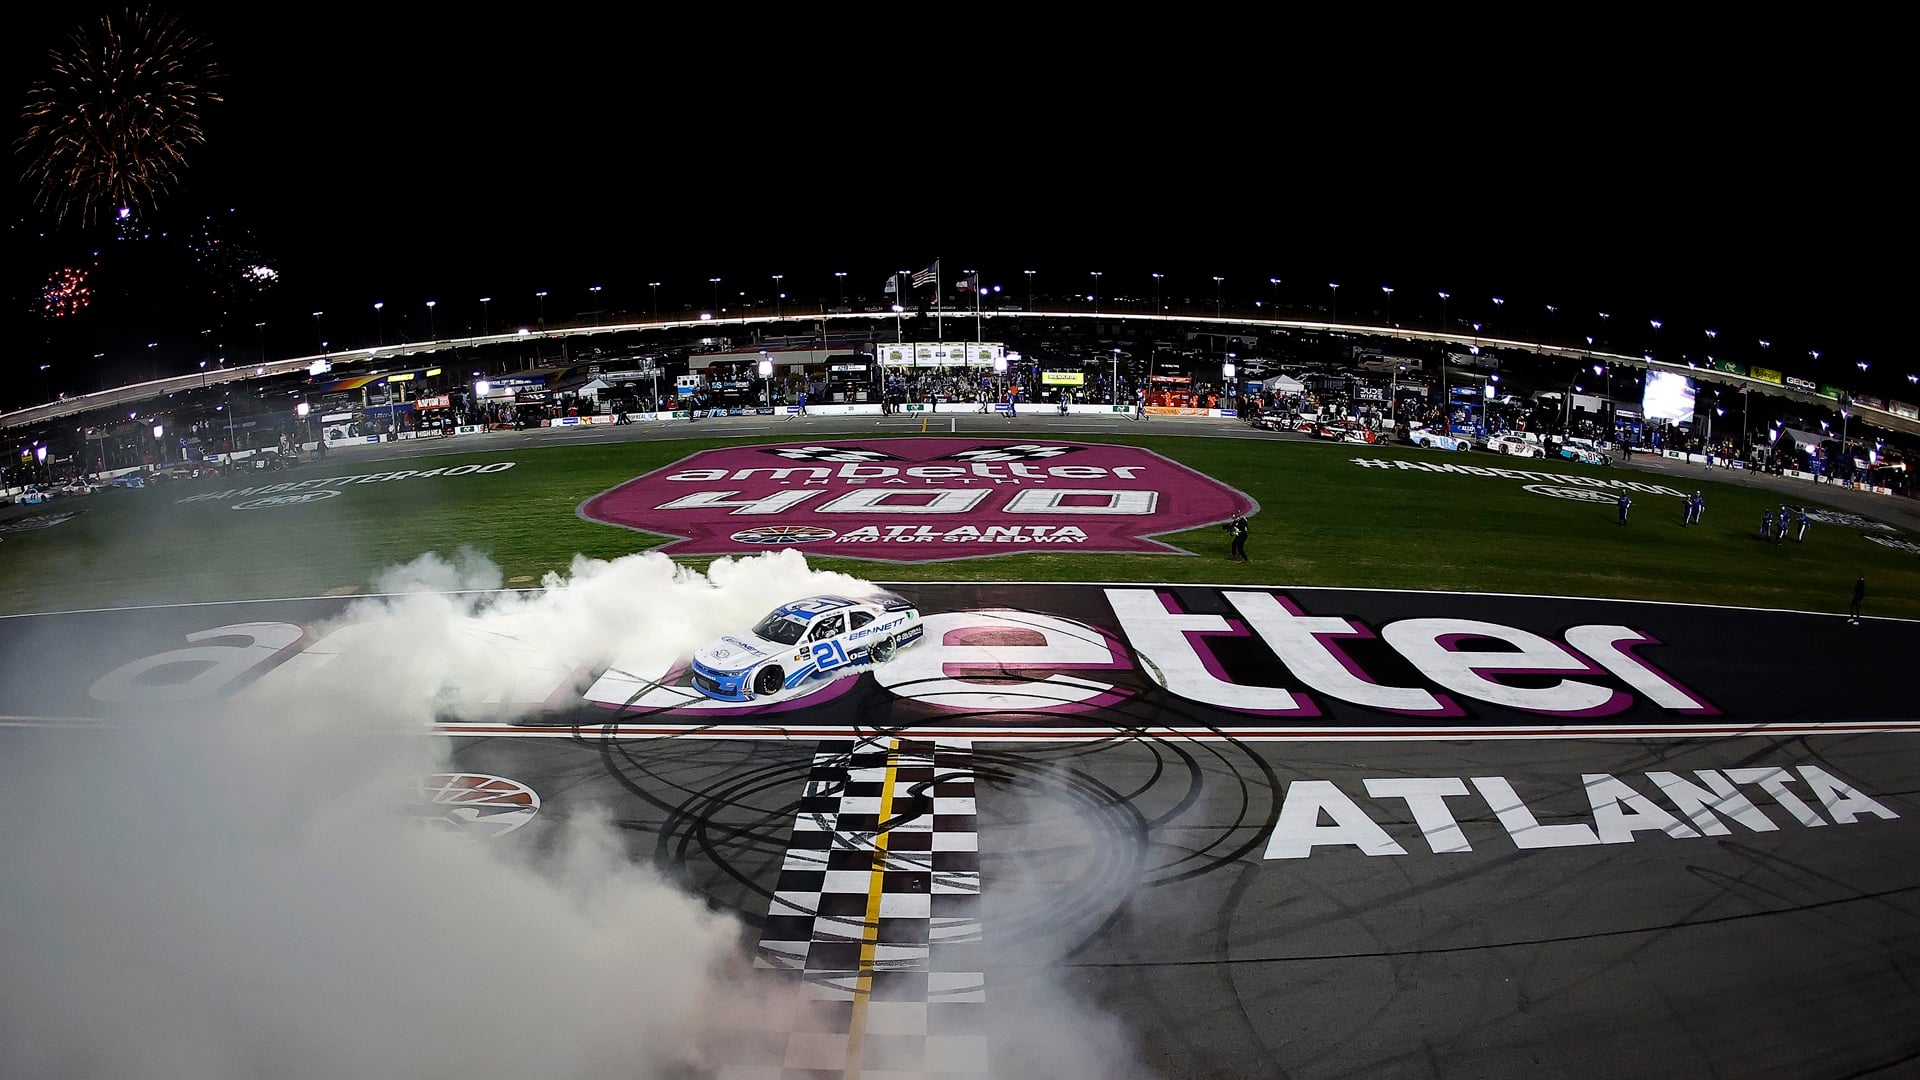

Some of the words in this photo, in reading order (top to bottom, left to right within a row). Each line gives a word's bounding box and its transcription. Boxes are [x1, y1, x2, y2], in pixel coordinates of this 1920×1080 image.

[1360, 387, 1383, 395] DUDE
[1786, 376, 1816, 389] GEICO
[192, 469, 200, 478] 5
[666, 463, 1146, 481] ambetter
[1350, 457, 1687, 497] #AMBETTER400
[174, 462, 515, 504] #AMBETTER400
[654, 488, 1159, 515] 400
[835, 535, 935, 543] MOTOR
[941, 535, 1088, 543] SPEEDWAY
[845, 525, 1088, 537] ATLANTA
[848, 617, 905, 641] BENNETT
[812, 639, 848, 669] 21
[1263, 765, 1899, 861] ATLANTA
